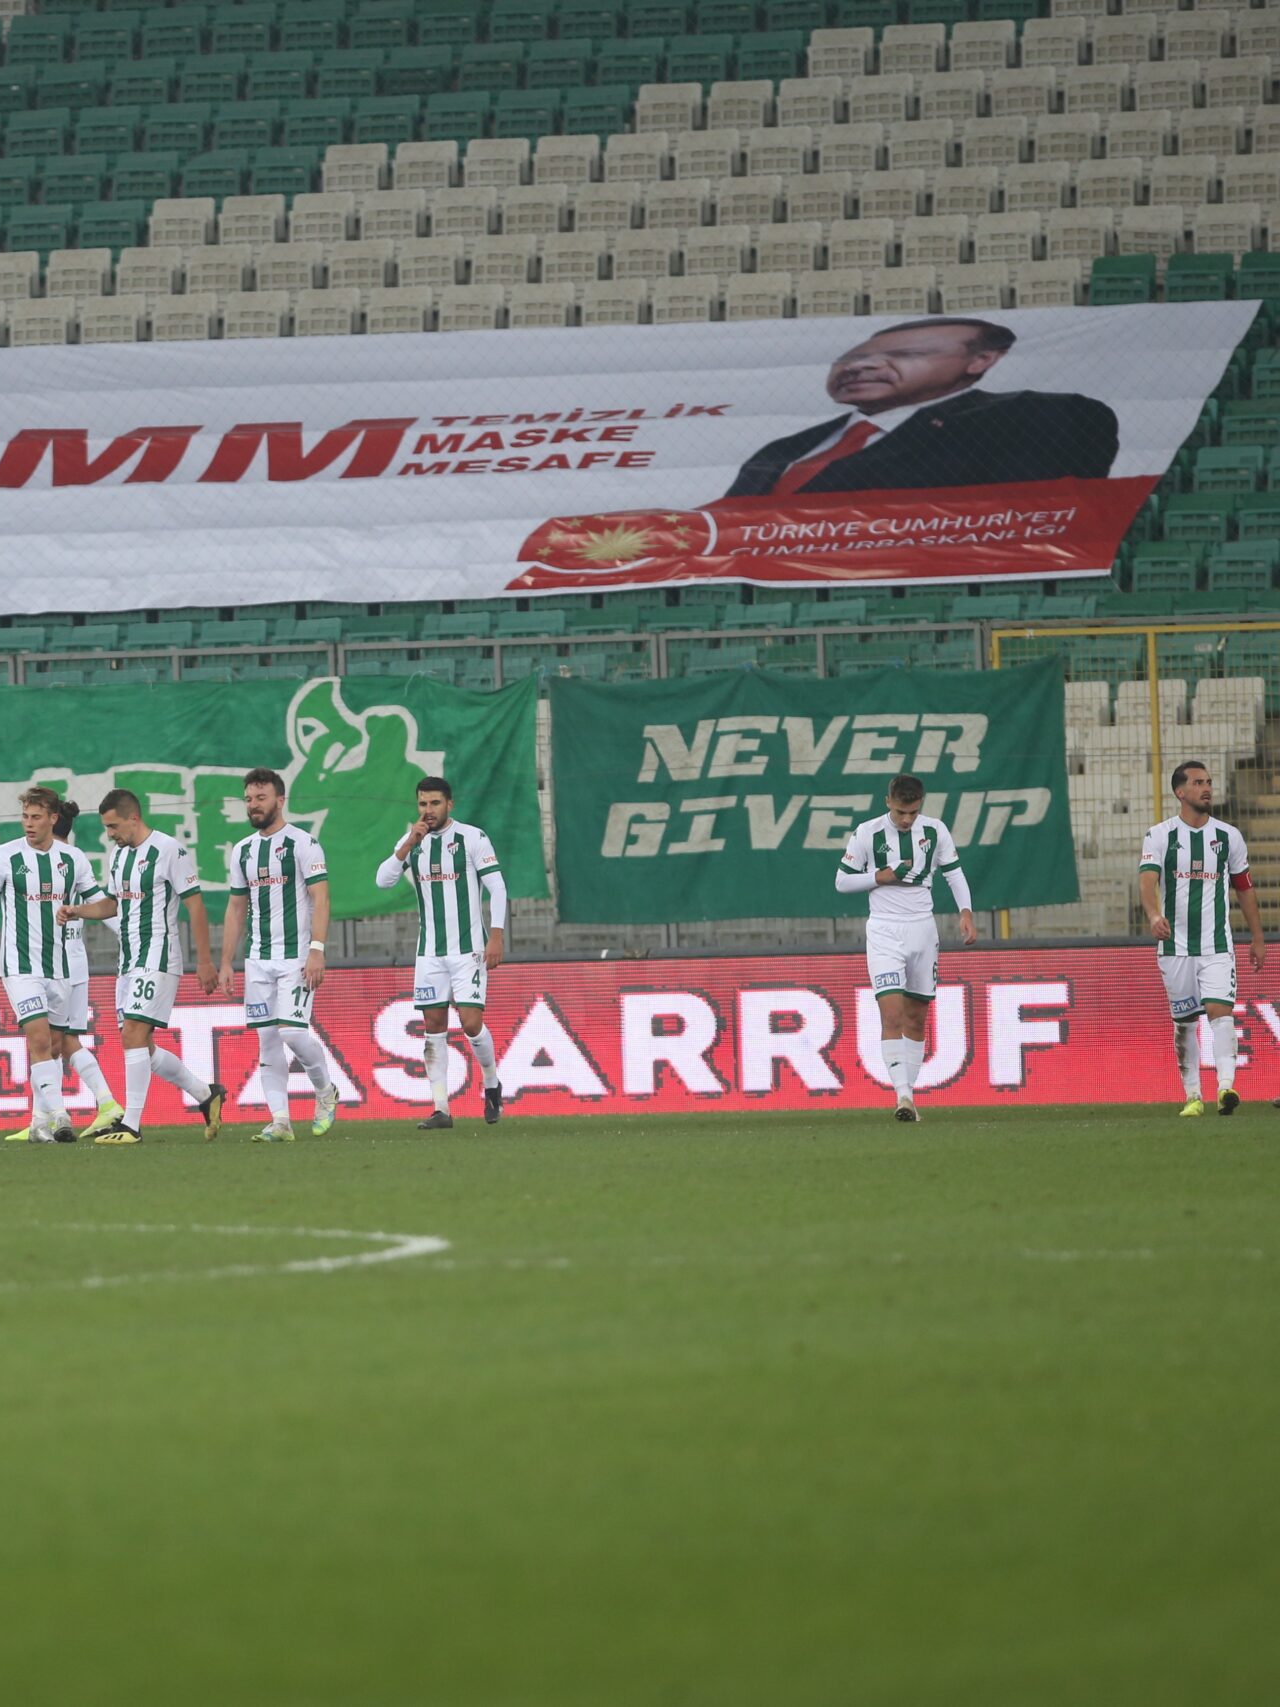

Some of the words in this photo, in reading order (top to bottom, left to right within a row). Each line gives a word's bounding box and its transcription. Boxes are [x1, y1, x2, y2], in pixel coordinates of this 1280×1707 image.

[431, 403, 735, 427] TEMİZLİK
[412, 425, 639, 455] MASKE
[397, 451, 657, 477] MESAFE
[739, 517, 862, 544] TÜRKİYE
[867, 507, 1077, 538] CUMHURİYETİ
[637, 712, 988, 784] NEVER
[600, 793, 873, 858] GIVE
[133, 978, 156, 1001] 36
[471, 968, 481, 988] 4
[291, 985, 311, 1008] 17
